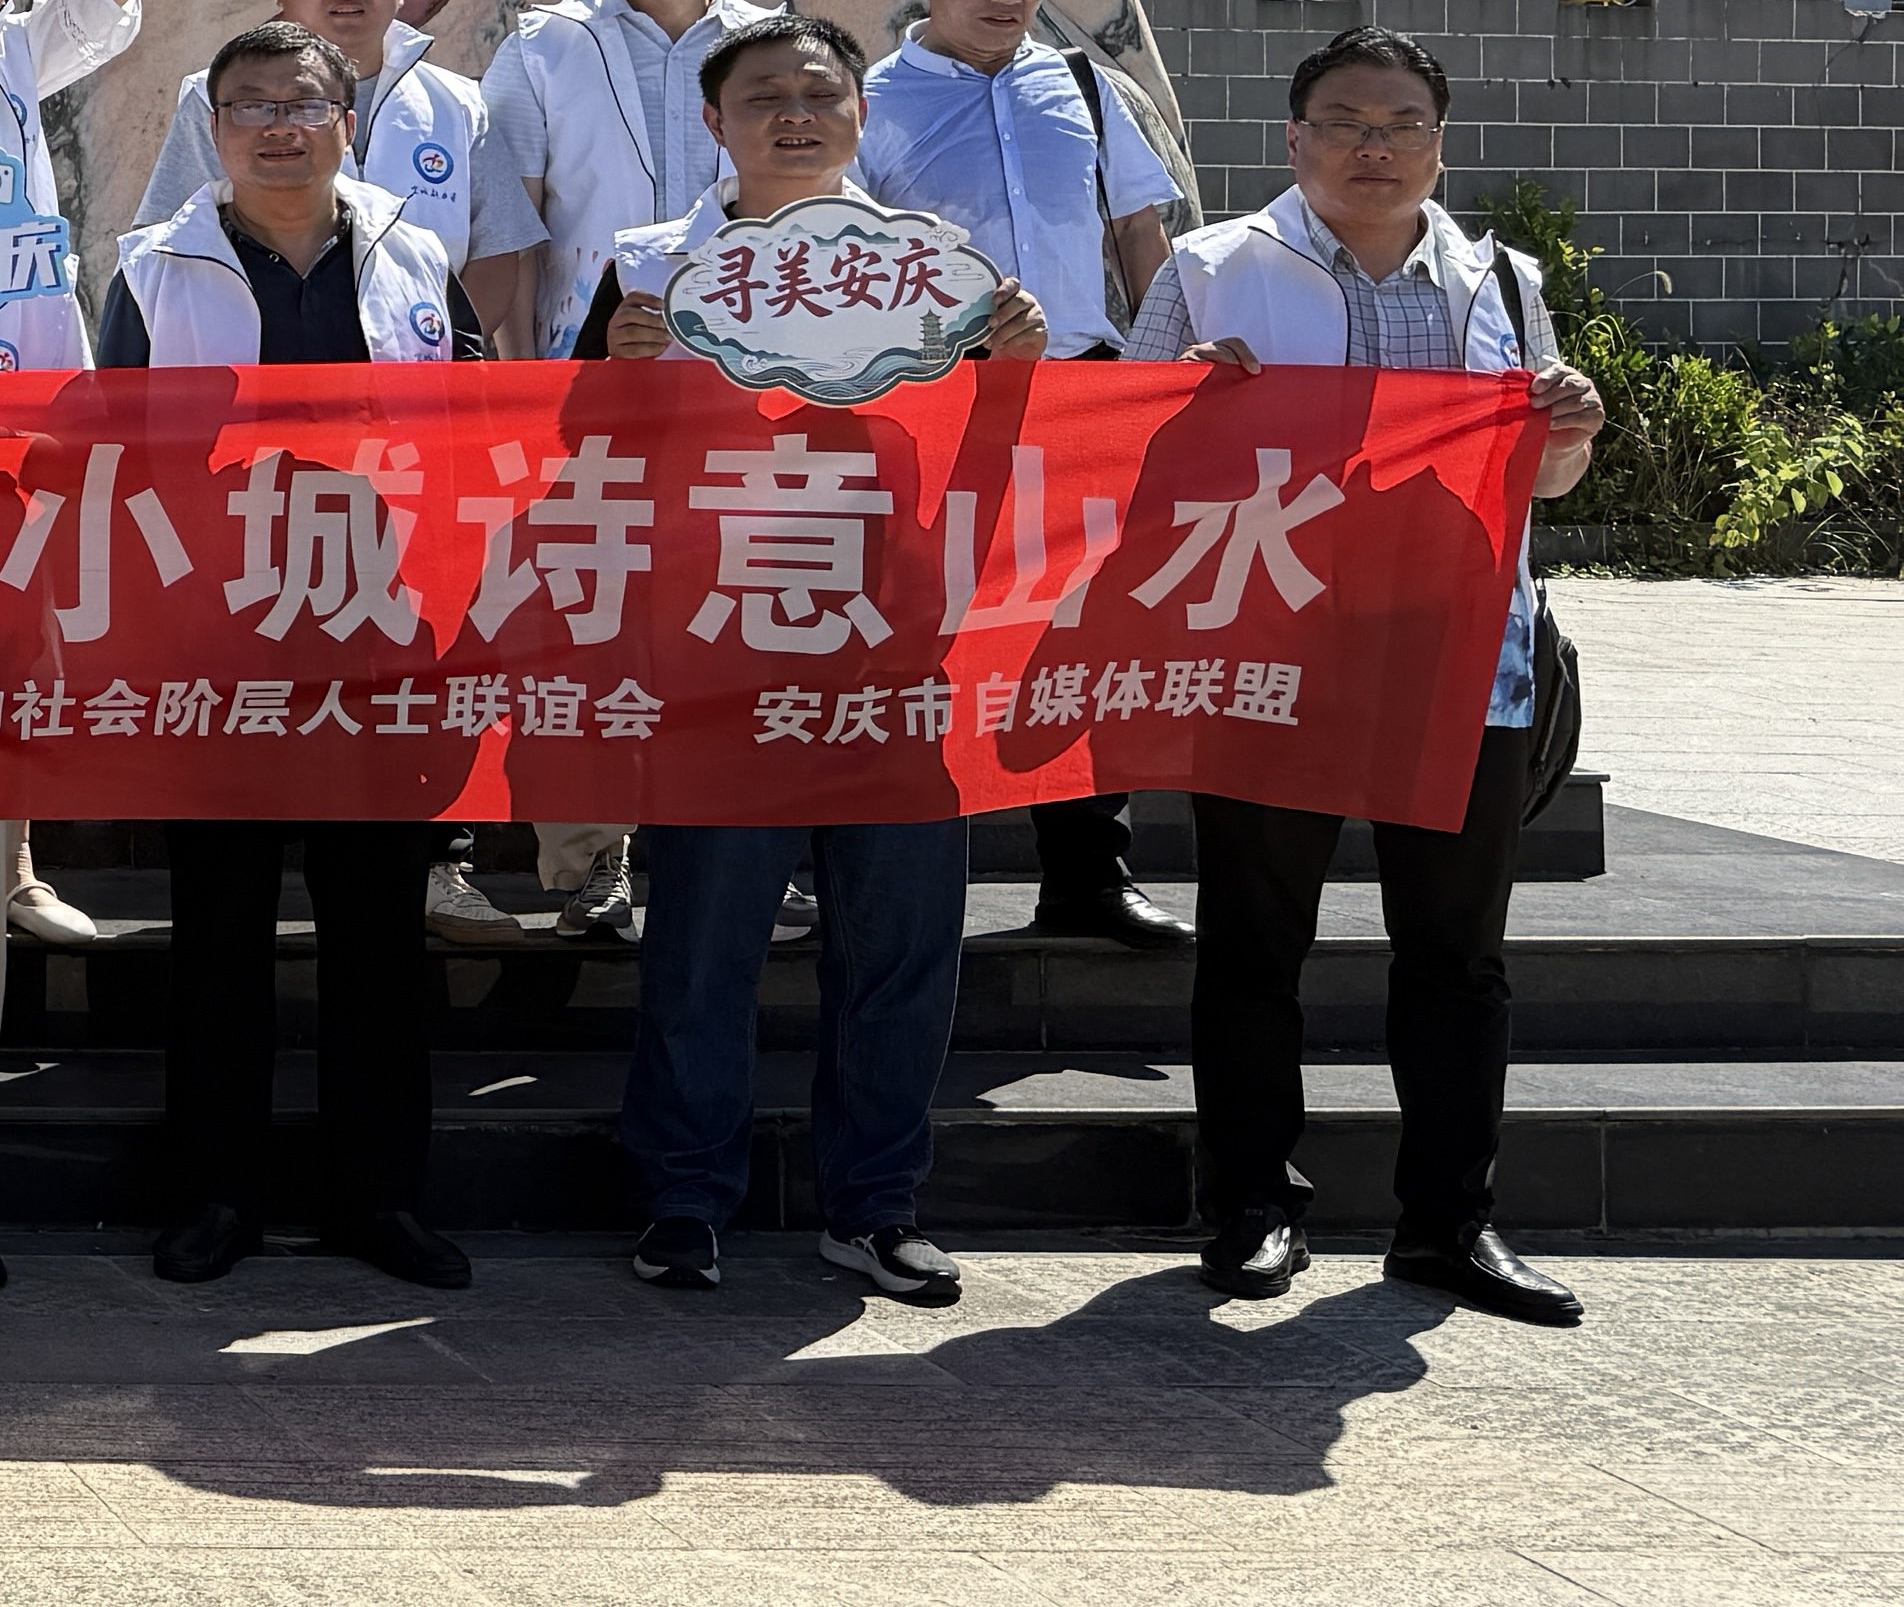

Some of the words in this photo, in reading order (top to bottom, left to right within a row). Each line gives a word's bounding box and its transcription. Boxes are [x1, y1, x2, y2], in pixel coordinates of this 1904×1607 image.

[699, 237, 963, 324] 寻美安庆
[752, 658, 1303, 745] 安庆市自媒体联盟
